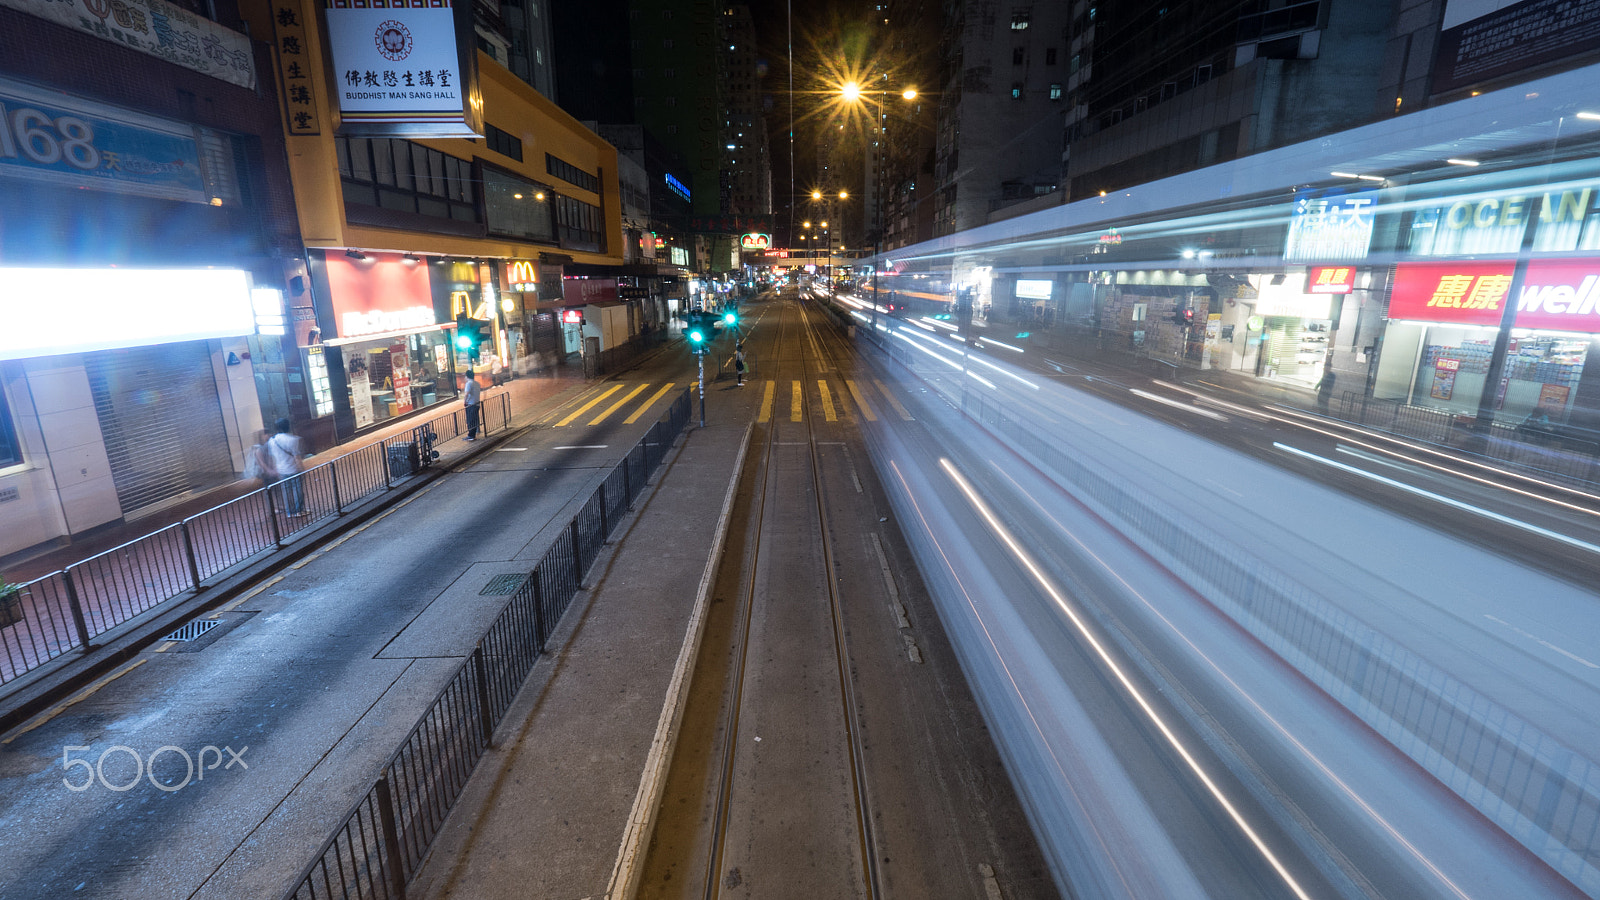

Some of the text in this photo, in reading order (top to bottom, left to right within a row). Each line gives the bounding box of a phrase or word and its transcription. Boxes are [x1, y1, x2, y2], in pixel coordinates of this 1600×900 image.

[346, 91, 456, 100] BUDDHIST MAN SANG HALL
[1427, 274, 1514, 310] 惠康
[1517, 275, 1600, 315] well
